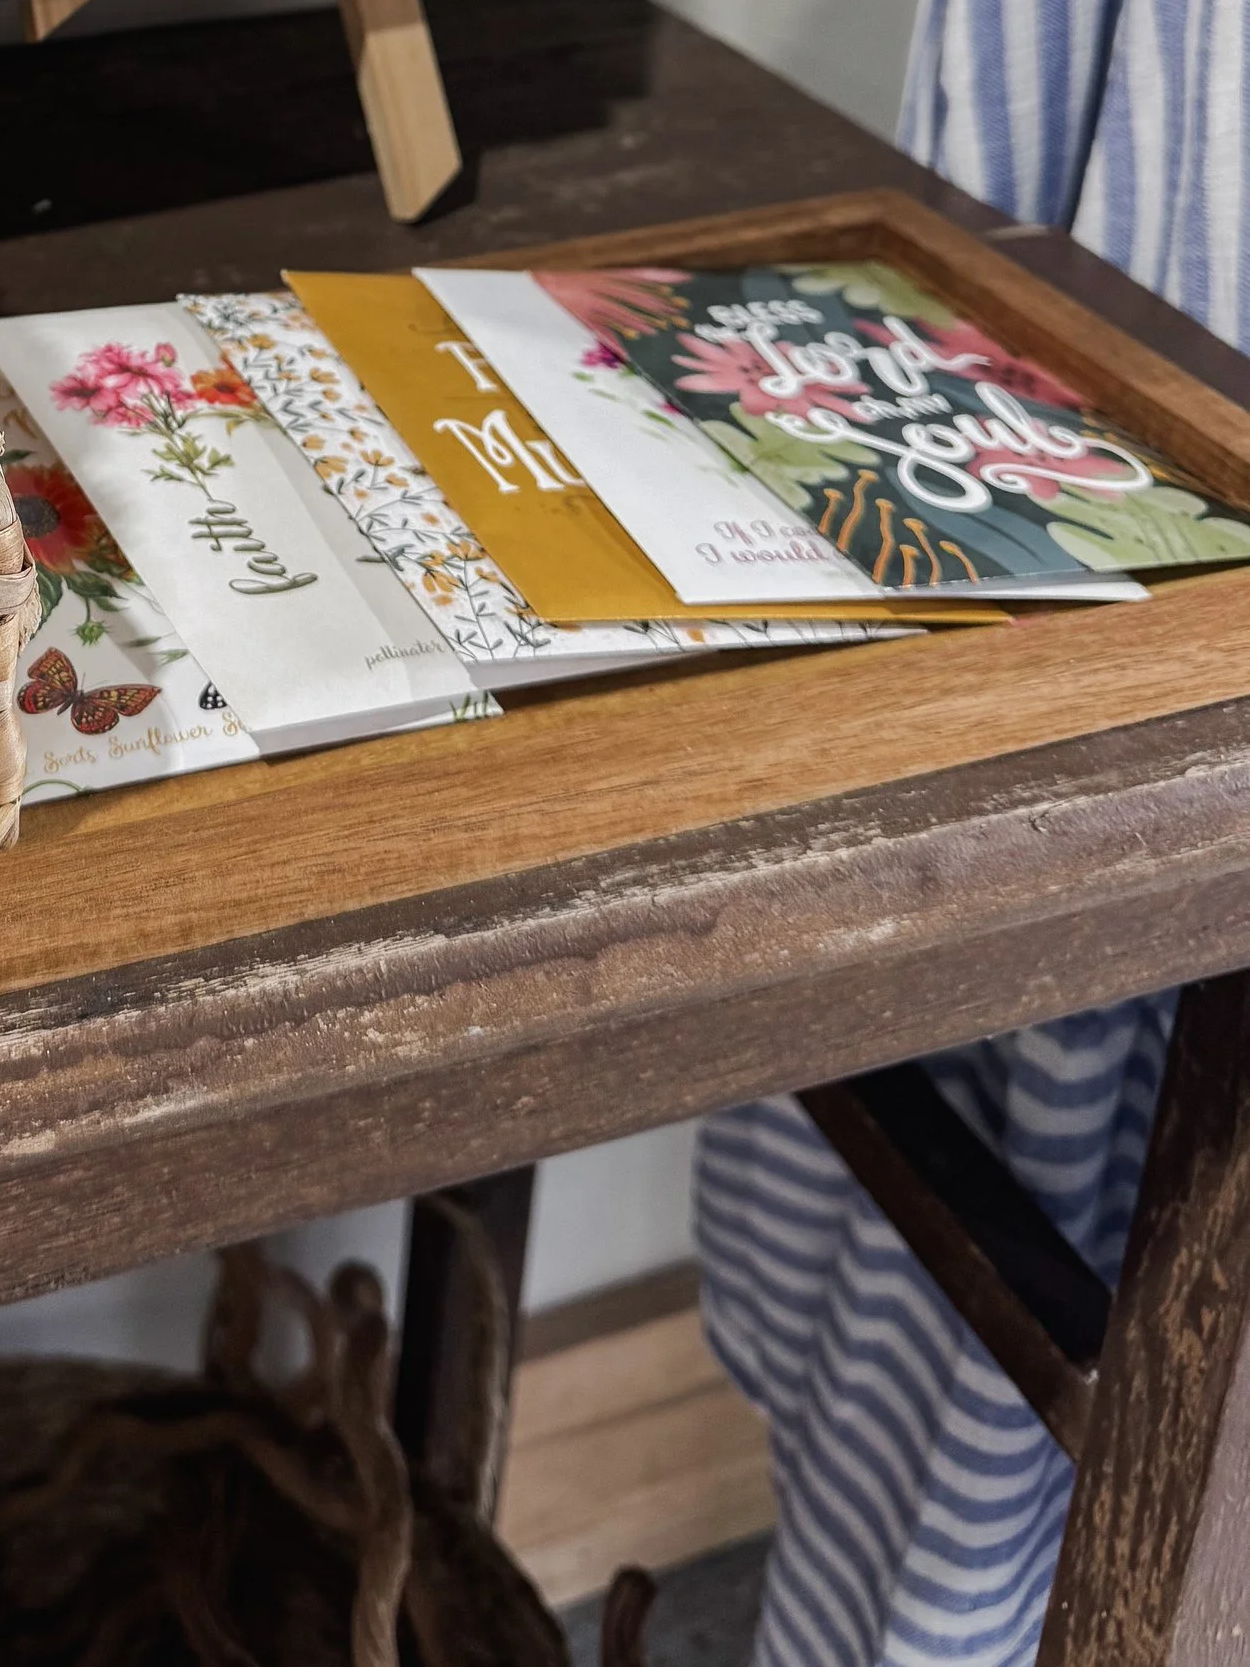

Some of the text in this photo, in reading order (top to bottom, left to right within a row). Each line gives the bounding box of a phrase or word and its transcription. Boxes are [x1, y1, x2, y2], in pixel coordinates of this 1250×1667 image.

[757, 315, 994, 399] Lord
[765, 381, 1153, 514] Soul
[107, 723, 213, 761] Sunflower
